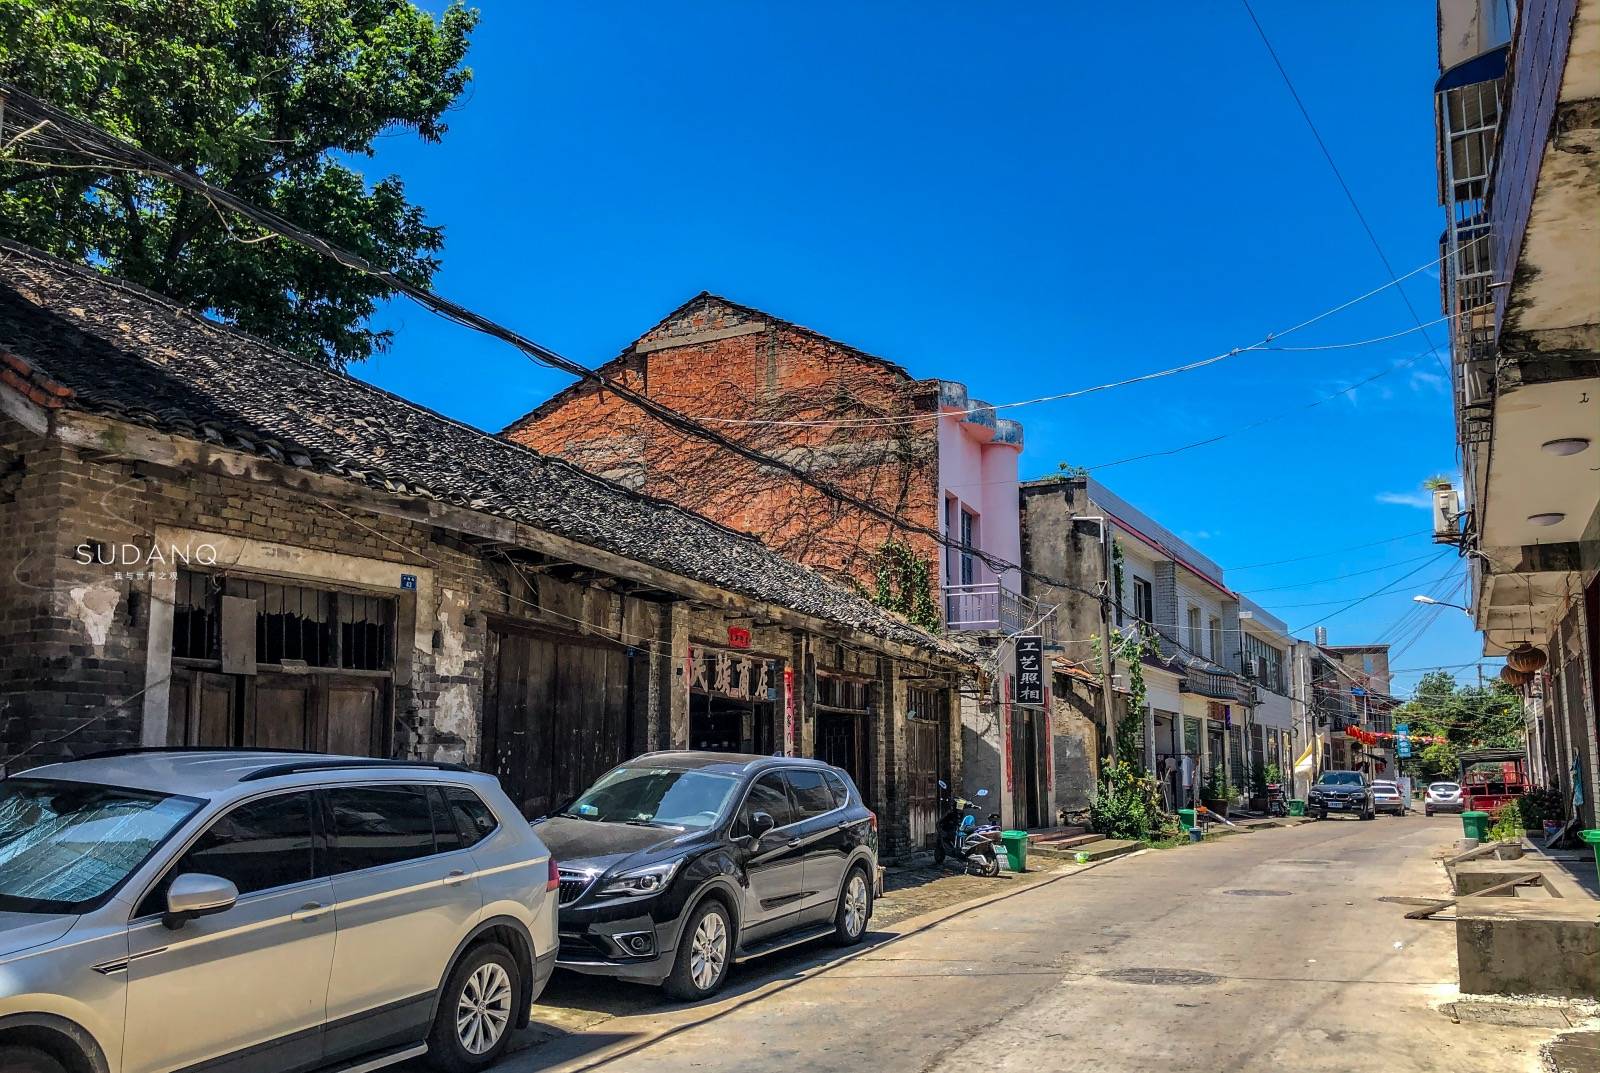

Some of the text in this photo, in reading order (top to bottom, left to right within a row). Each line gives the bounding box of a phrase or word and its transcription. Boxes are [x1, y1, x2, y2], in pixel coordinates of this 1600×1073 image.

[689, 648, 768, 701] 民族商店
[1018, 641, 1040, 700] 工艺照相
